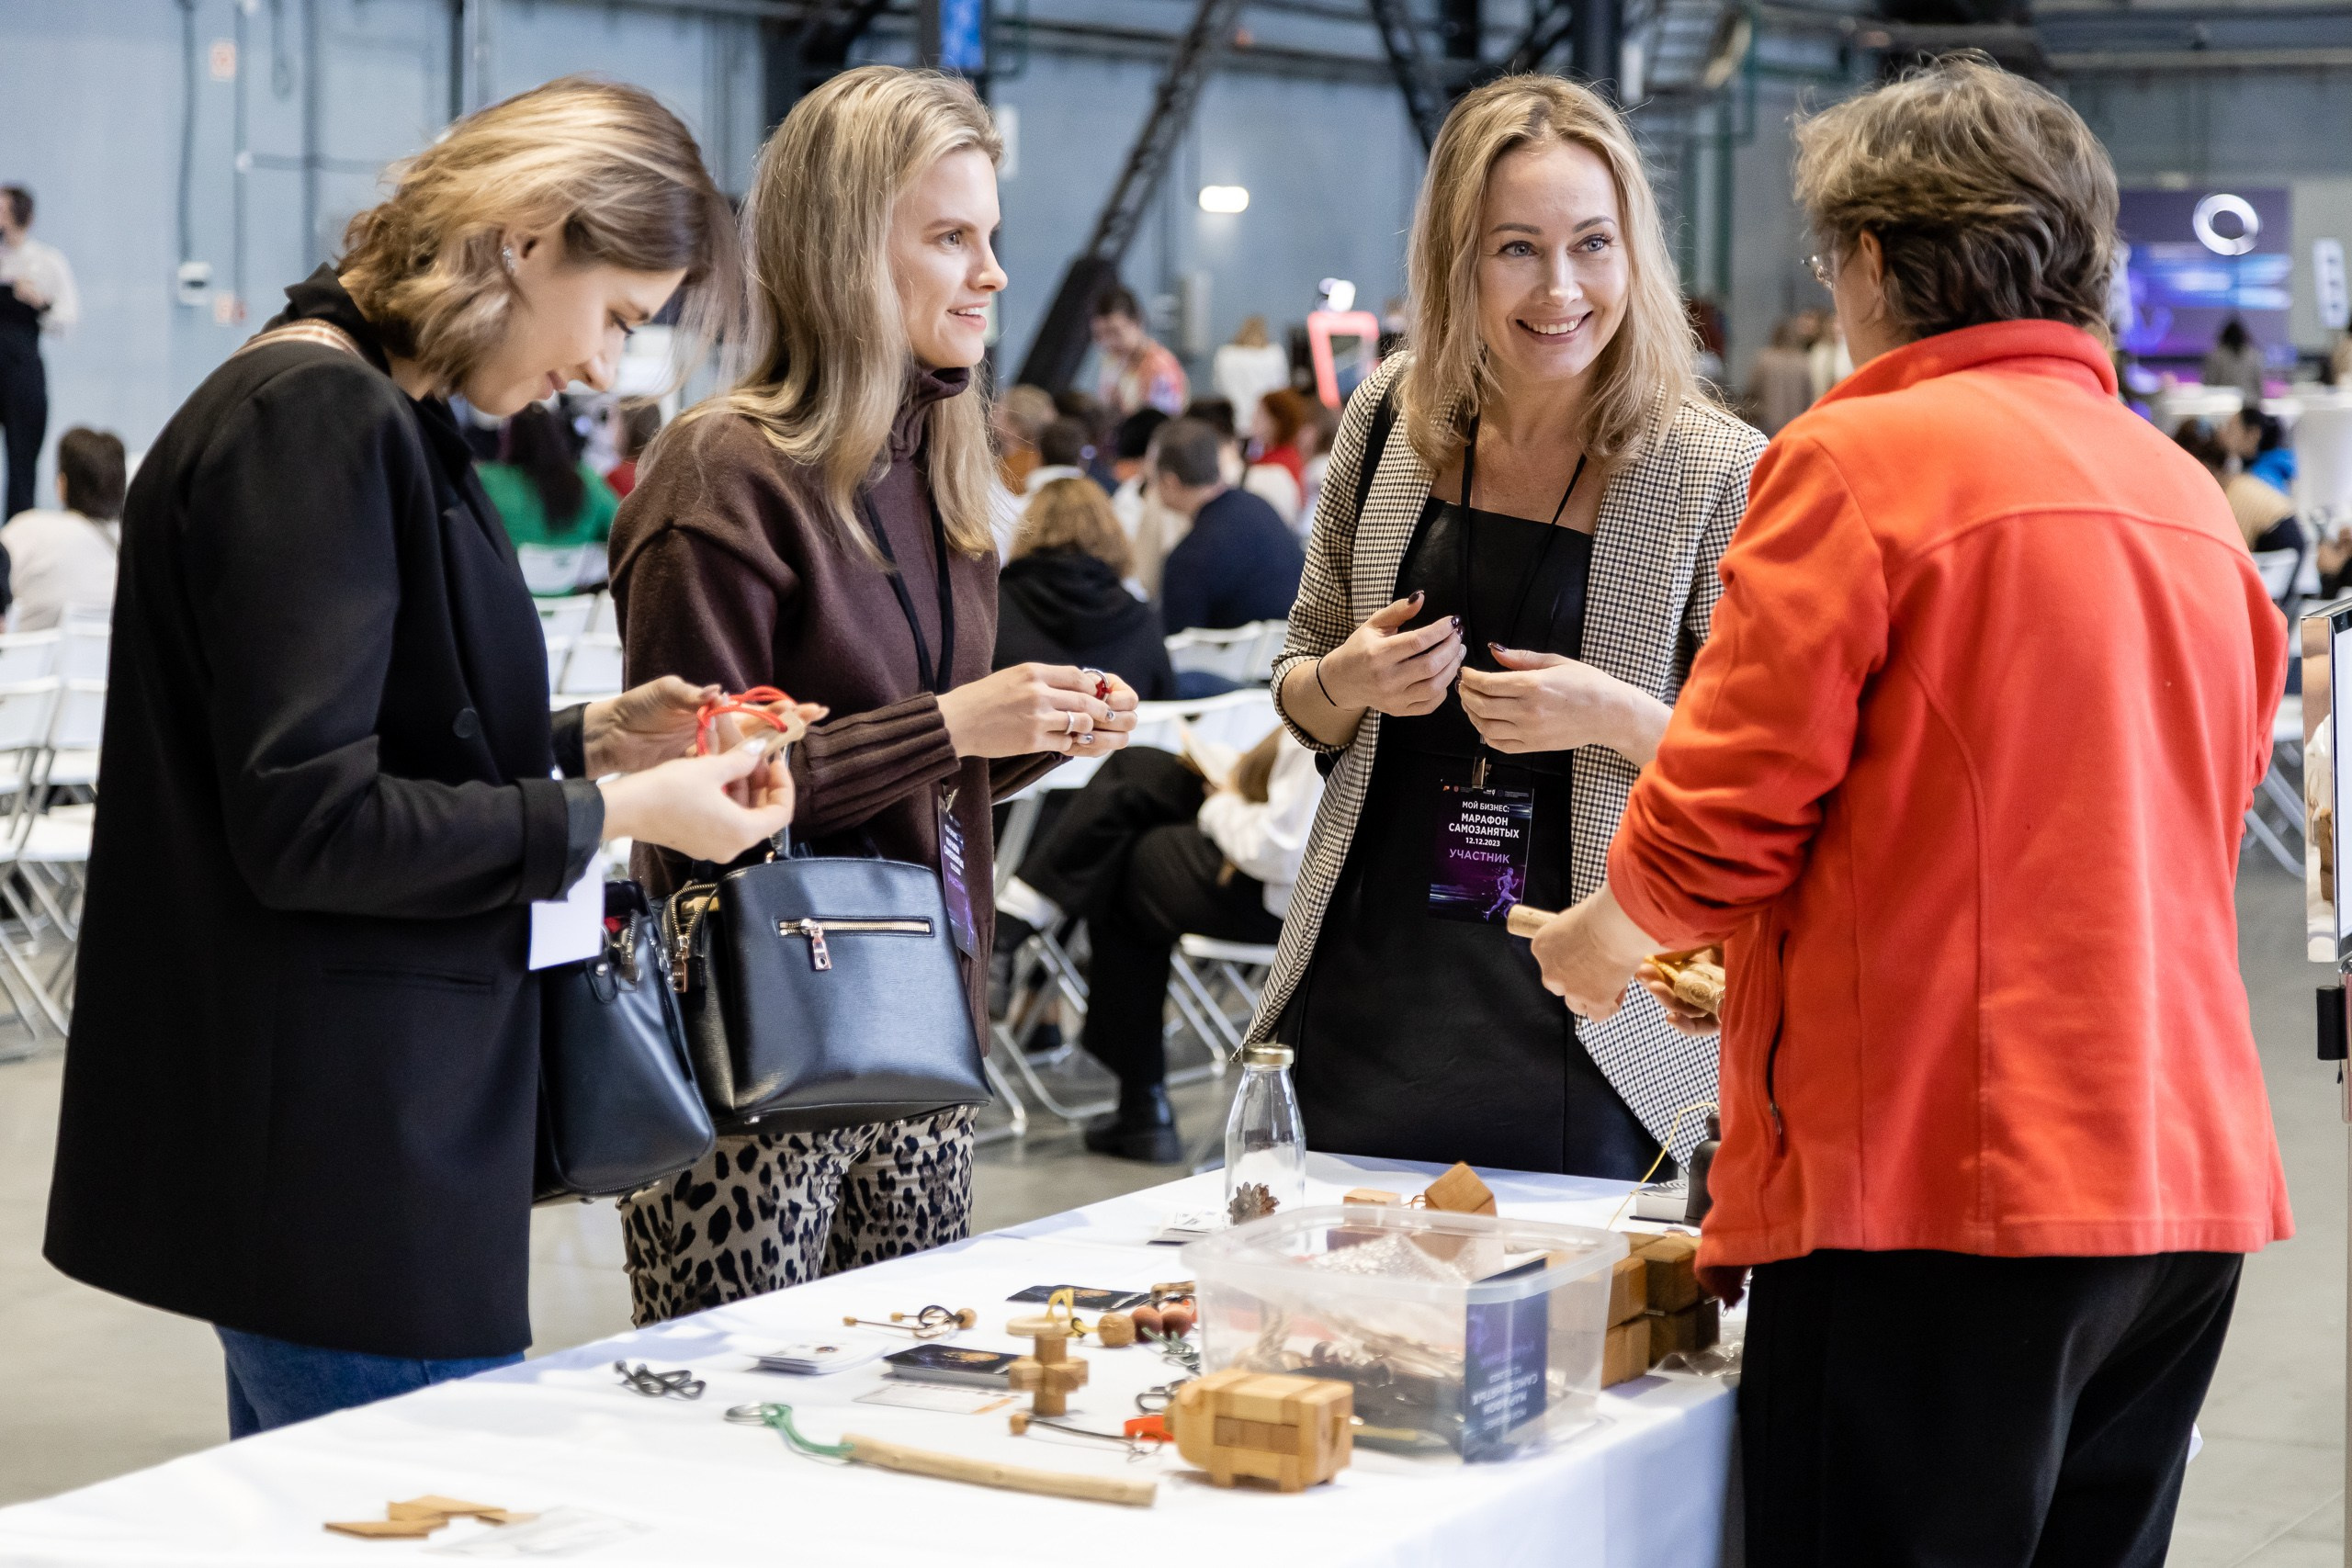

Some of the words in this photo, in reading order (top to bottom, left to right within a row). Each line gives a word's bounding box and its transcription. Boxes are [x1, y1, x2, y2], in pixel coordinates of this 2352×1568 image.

[1463, 801, 1478, 809] МОЙ
[1480, 803, 1510, 812] БИЗНЕС:
[1462, 813, 1508, 826] МАРАФОН
[1449, 823, 1520, 838] САМОЗАНЯТЫХ
[1465, 837, 1500, 847] 12.12.2023
[1449, 848, 1510, 863] УЧАСТНИК
